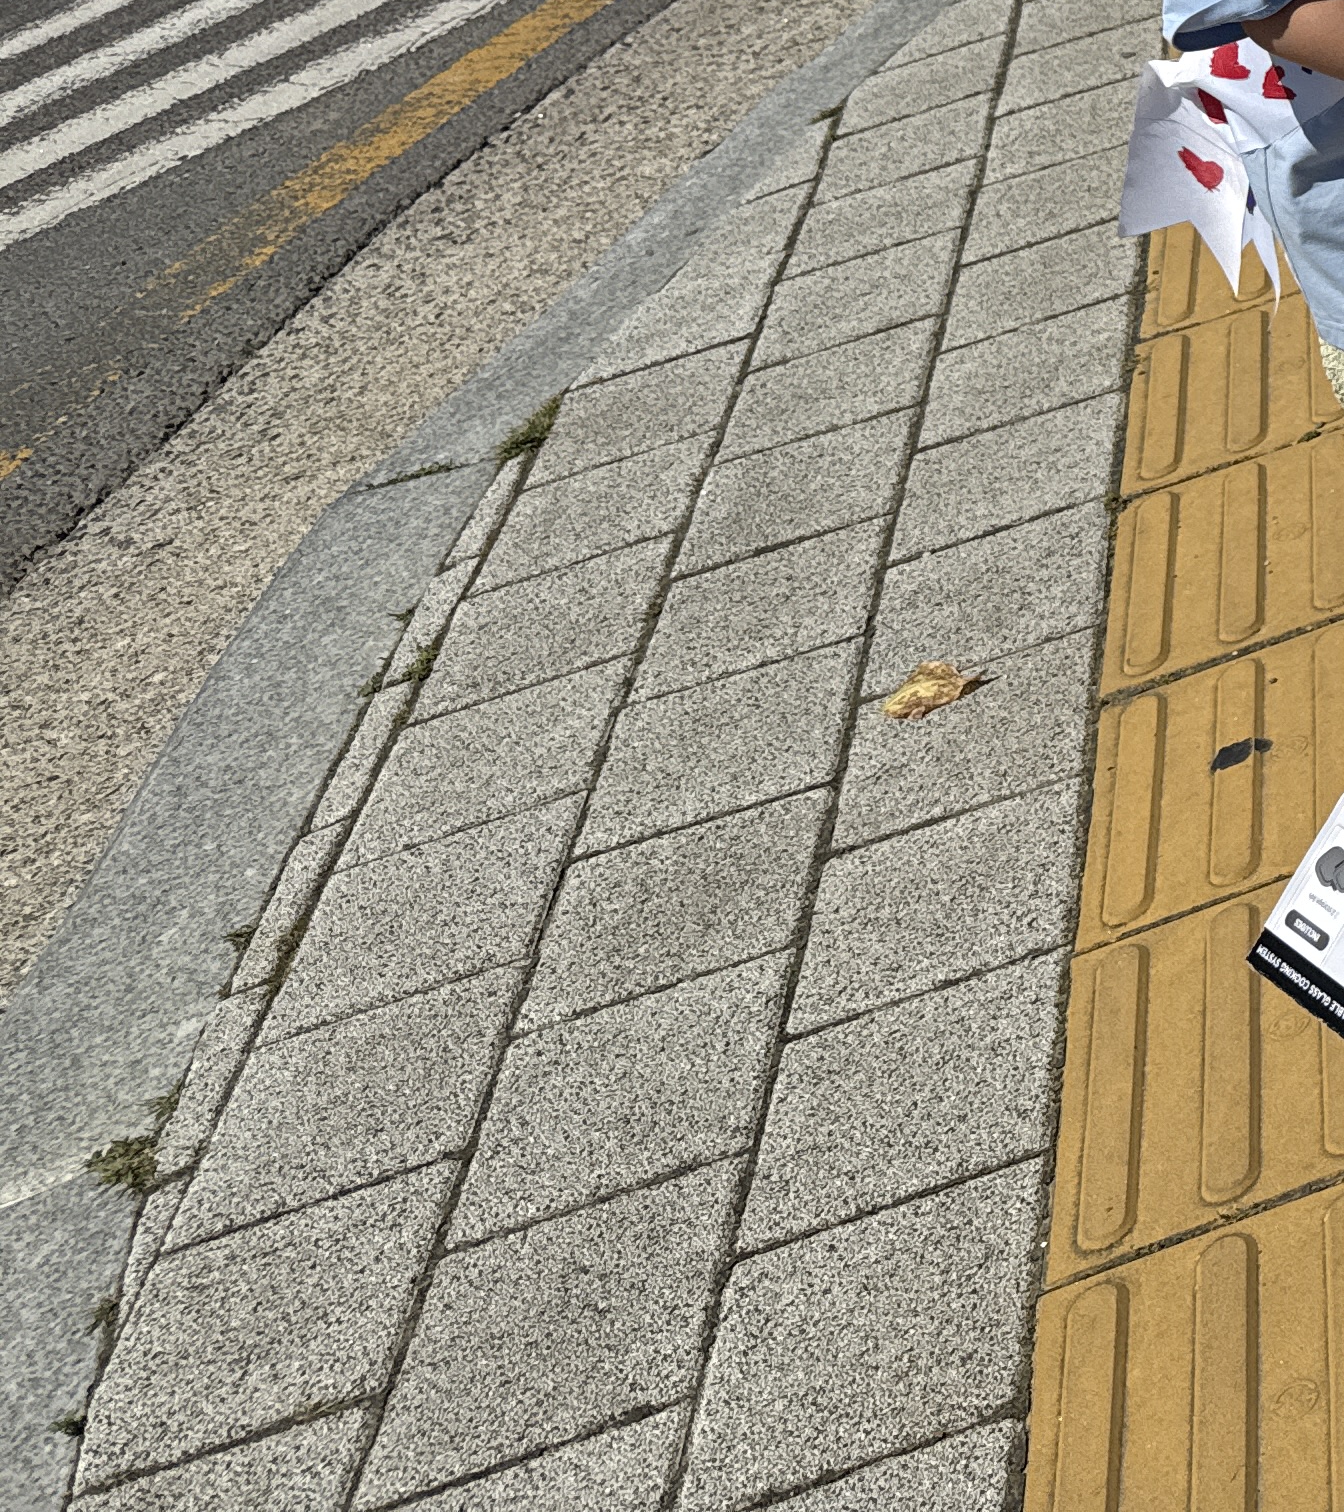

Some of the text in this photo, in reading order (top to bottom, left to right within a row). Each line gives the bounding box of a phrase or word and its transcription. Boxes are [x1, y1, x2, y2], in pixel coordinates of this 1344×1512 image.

[1292, 917, 1321, 942] INCLUDES
[1254, 943, 1282, 967] SYSTEM
[1278, 961, 1311, 990] COOKING
[1307, 983, 1332, 1006] GLASS
